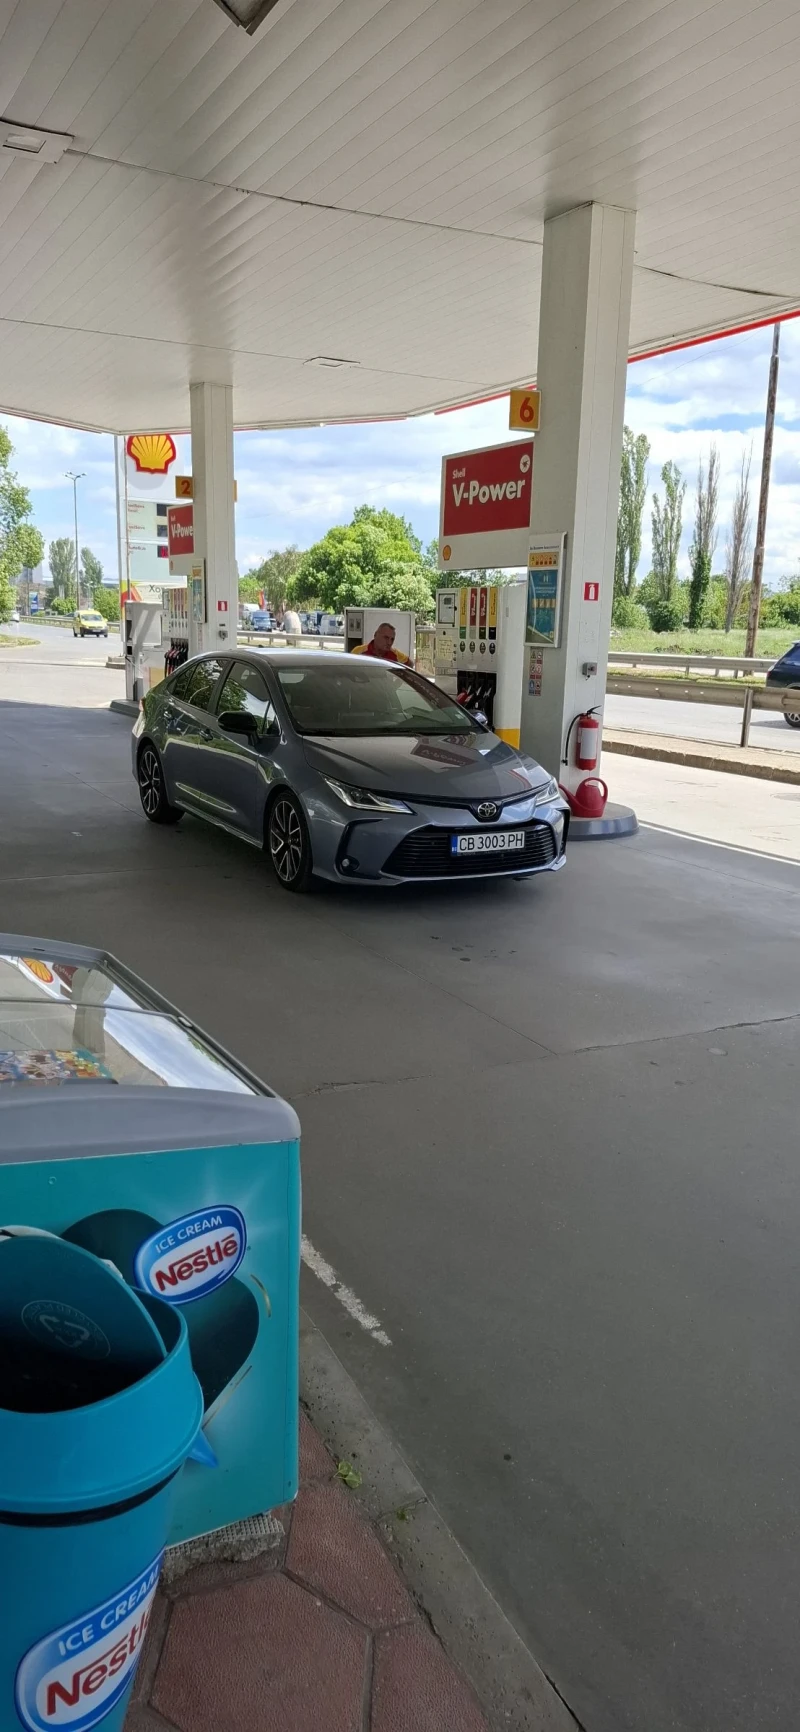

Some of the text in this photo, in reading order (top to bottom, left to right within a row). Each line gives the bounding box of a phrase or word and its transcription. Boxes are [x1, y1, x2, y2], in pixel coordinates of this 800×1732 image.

[519, 397, 534, 423] 6
[452, 468, 466, 479] Shell
[181, 480, 191, 495] 2
[452, 479, 526, 507] V-Power
[459, 837, 475, 851] CB
[477, 834, 506, 850] 3003
[508, 833, 523, 847] PH
[155, 1215, 223, 1254] ICE CREAM
[58, 1623, 95, 1656] ICE
